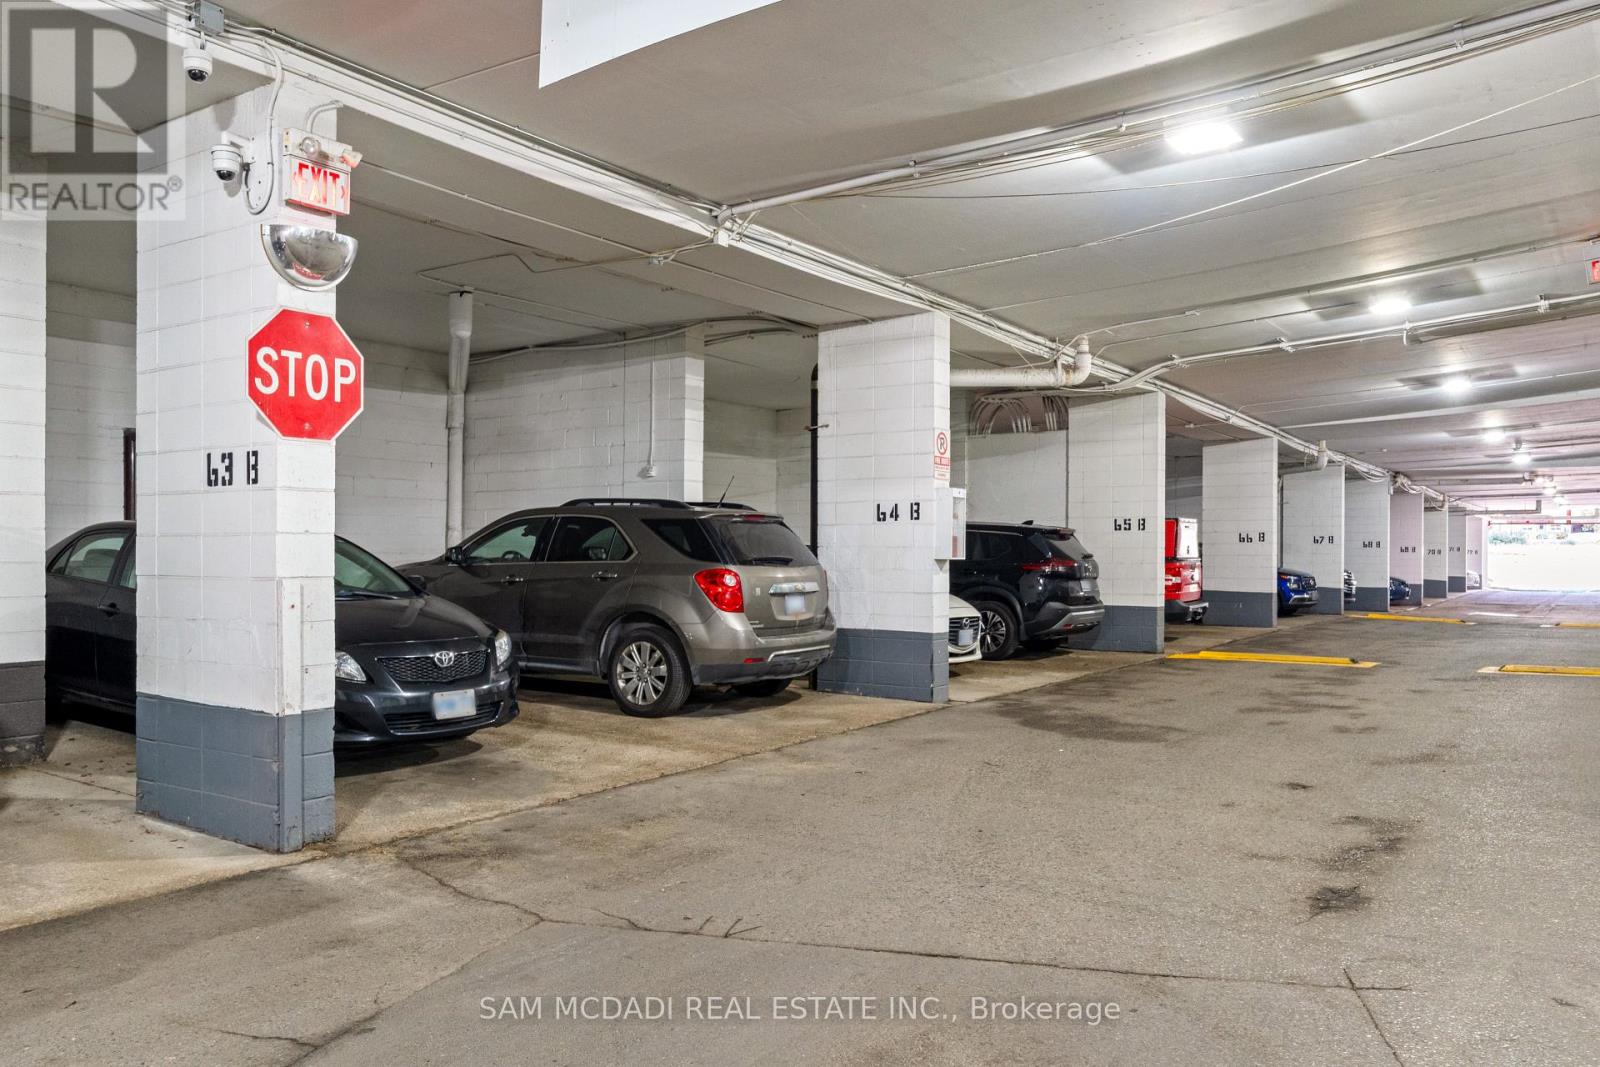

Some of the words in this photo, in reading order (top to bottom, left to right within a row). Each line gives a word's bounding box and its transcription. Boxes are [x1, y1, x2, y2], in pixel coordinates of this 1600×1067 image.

[298, 162, 340, 207] EXIT
[254, 346, 356, 402] STOP
[206, 452, 234, 487] 63
[246, 450, 259, 486] B
[876, 503, 900, 522] 64
[910, 502, 921, 521] B
[1114, 518, 1132, 531] 65
[1138, 518, 1146, 531] B
[1238, 532, 1253, 543] 66
[1258, 532, 1265, 542] B
[1313, 536, 1324, 544] 67
